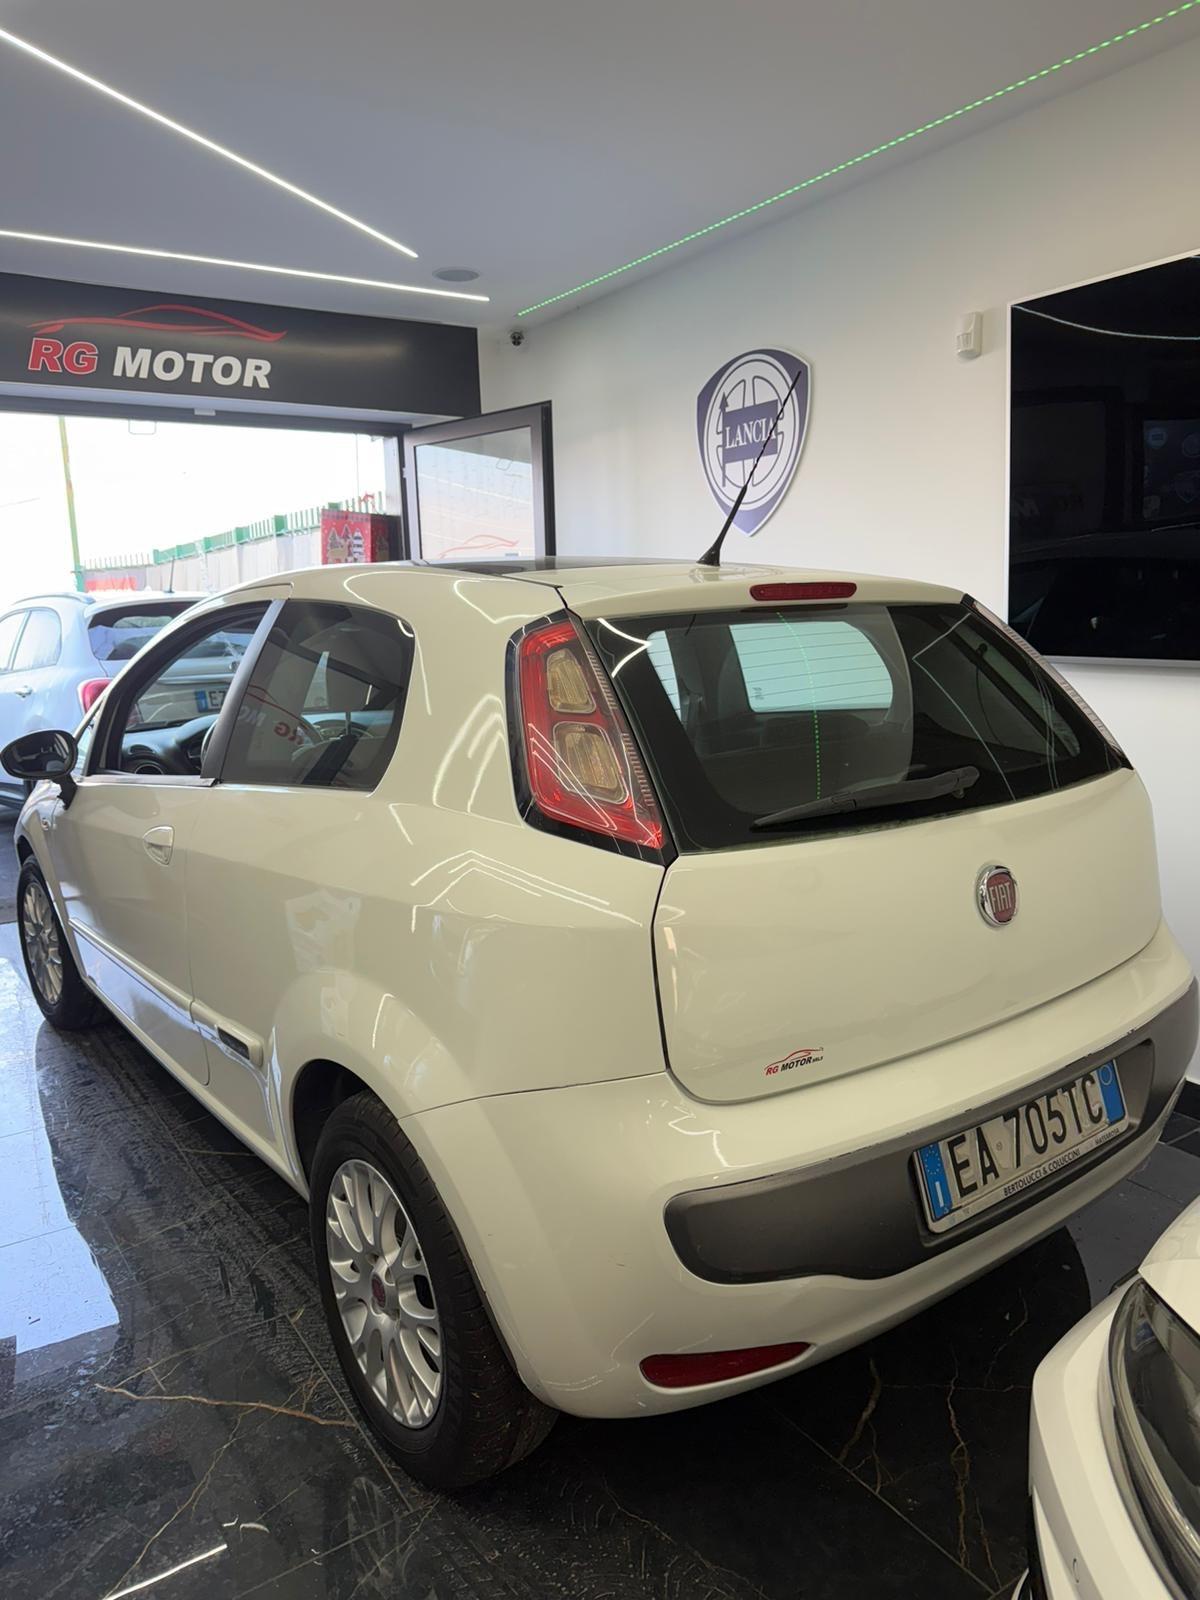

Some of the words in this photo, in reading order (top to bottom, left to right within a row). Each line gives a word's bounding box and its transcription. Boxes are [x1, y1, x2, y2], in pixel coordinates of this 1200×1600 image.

[28, 338, 98, 375] RG
[113, 347, 272, 389] MOTOR
[725, 417, 776, 449] LANCIA
[989, 882, 1012, 912] FIAT
[766, 1065, 779, 1075] RG
[781, 1056, 812, 1072] MOTOR
[948, 1126, 1000, 1198] EA
